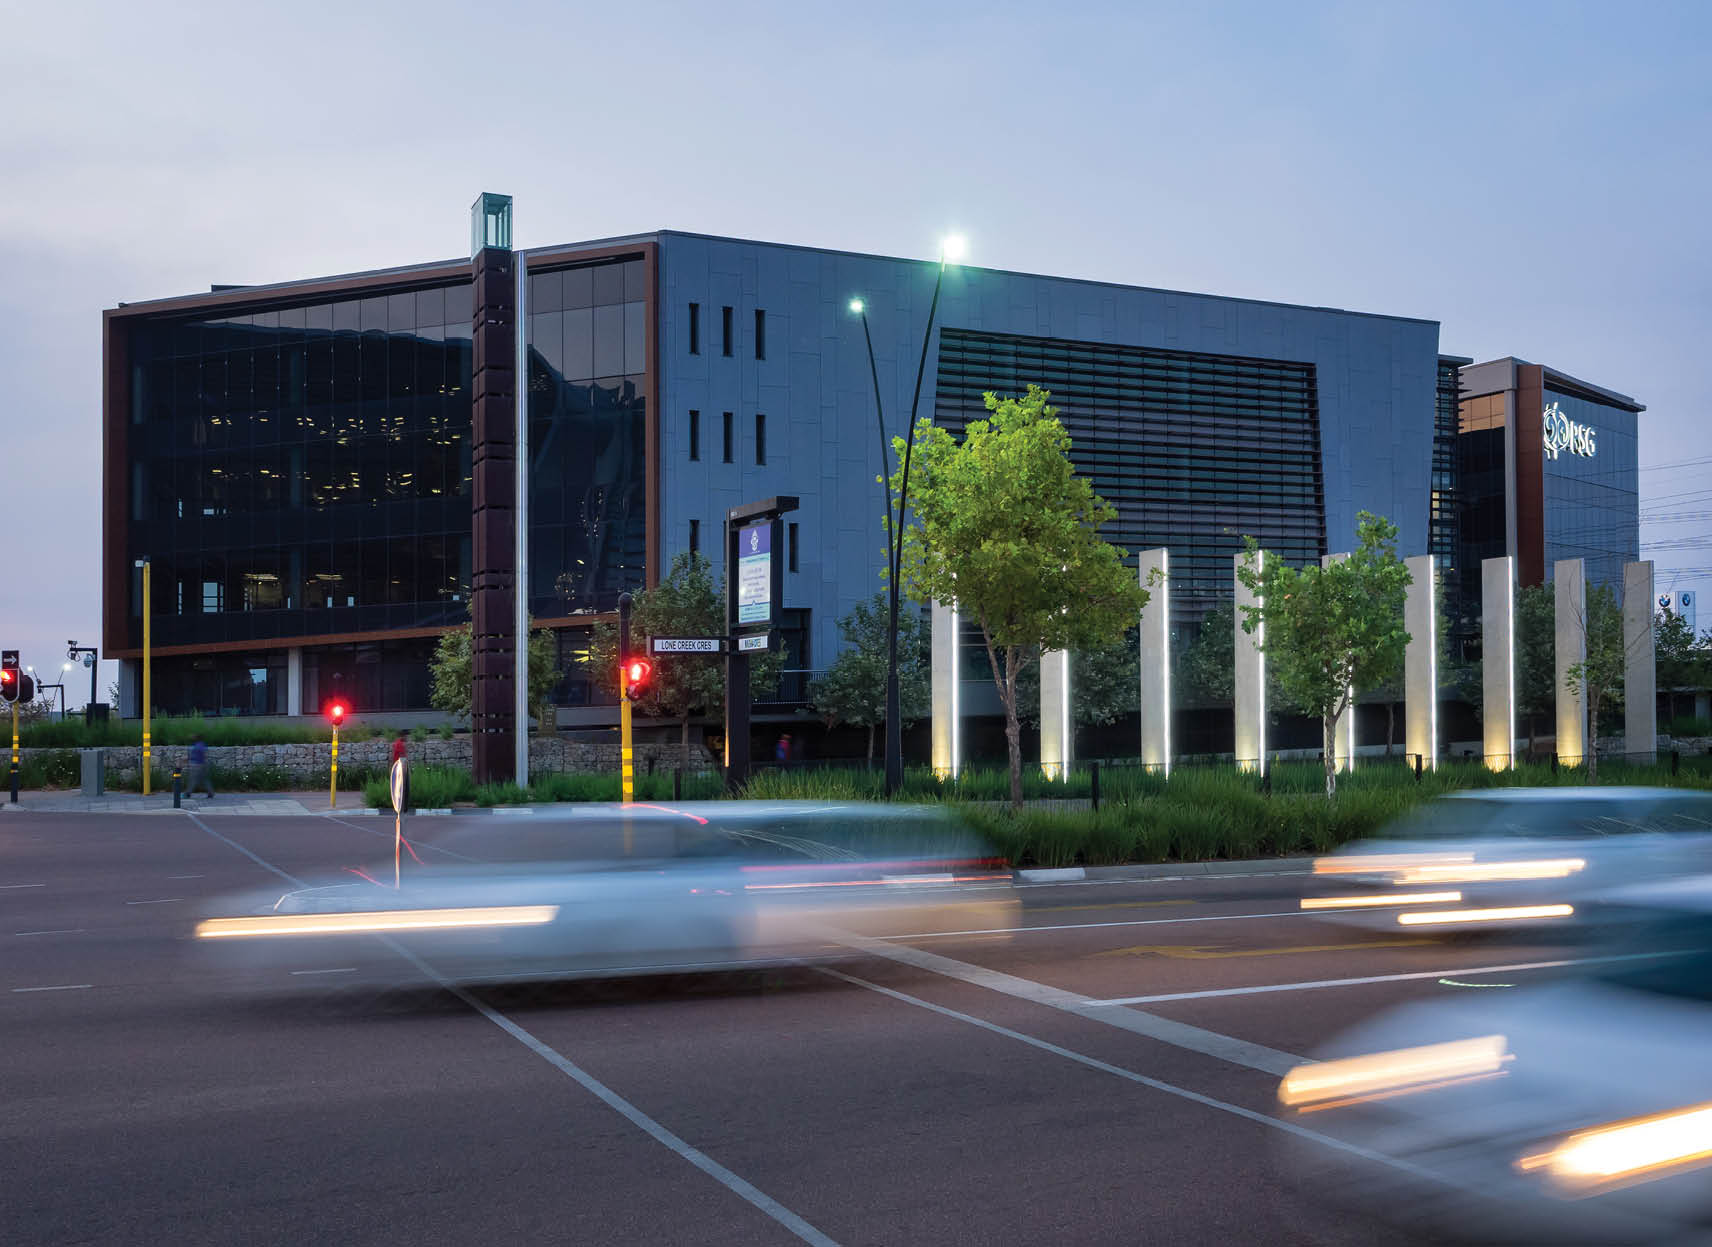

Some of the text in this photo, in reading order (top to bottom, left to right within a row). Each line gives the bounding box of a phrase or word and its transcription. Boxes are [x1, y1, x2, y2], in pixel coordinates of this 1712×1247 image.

[661, 640, 712, 650] LONE CREEK CRES
